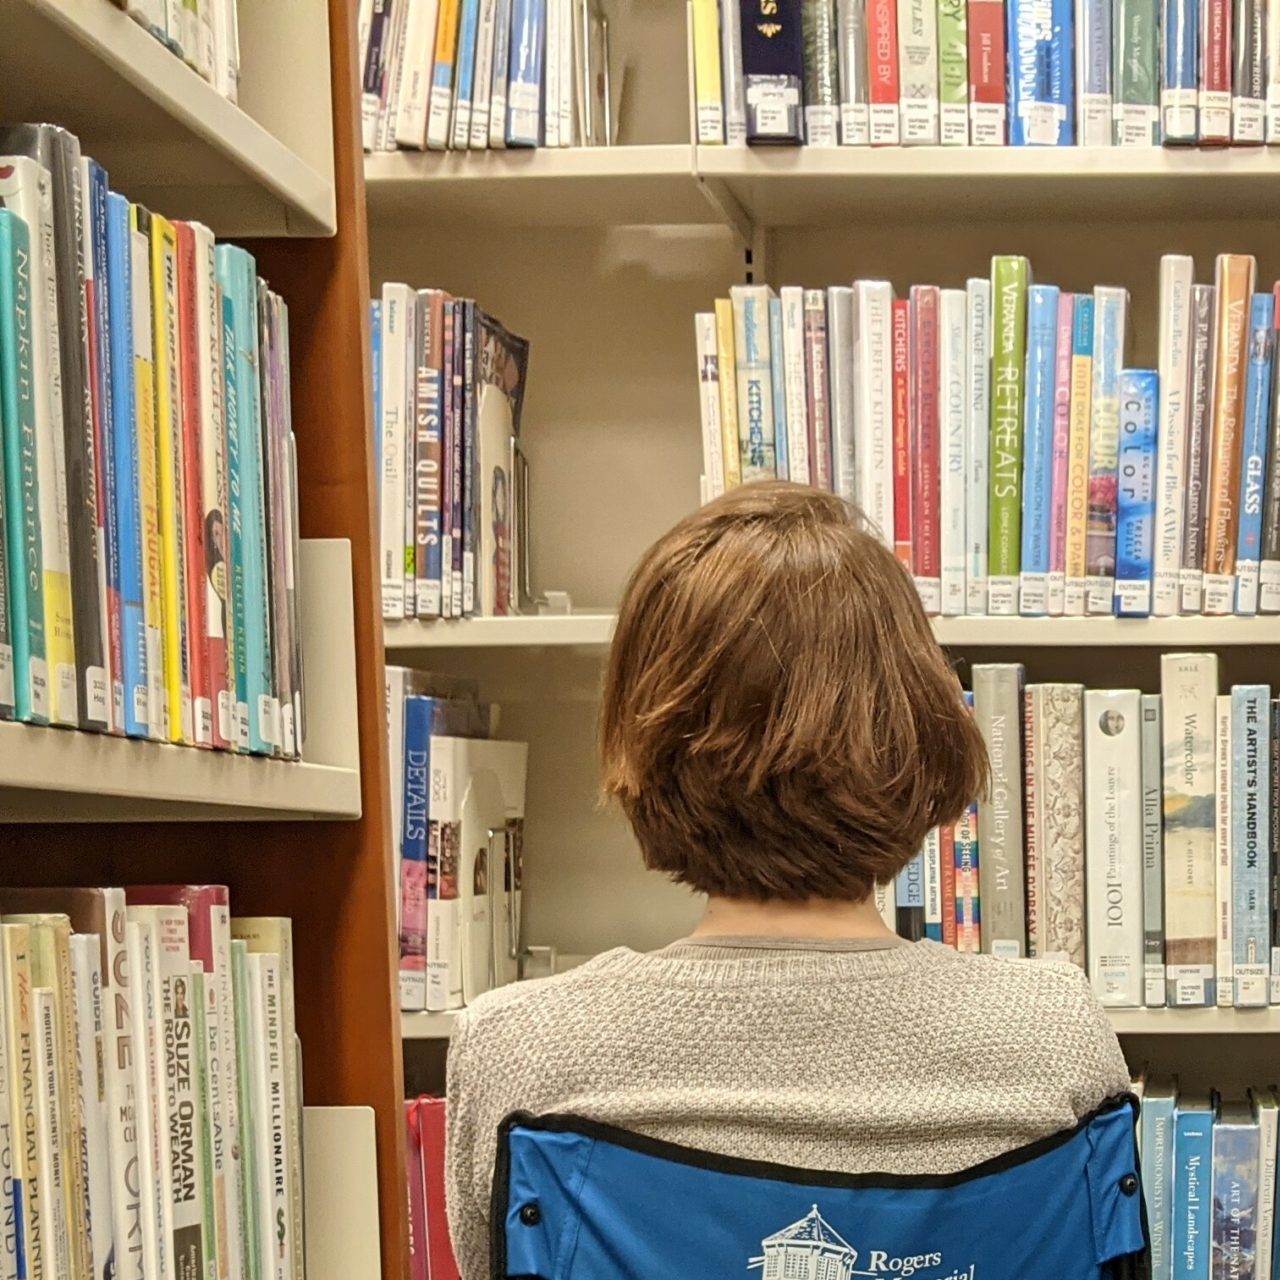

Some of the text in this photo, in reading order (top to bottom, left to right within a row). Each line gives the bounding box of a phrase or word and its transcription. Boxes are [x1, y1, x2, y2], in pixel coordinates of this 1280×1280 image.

[895, 309, 907, 372] KITCHENS
[973, 294, 985, 411] COTTAGE LIVING
[994, 281, 1019, 498] VERANDA RETREATS
[15, 249, 40, 593] Napkin Finance
[224, 323, 242, 539] TALK MONEY TO ME
[417, 366, 439, 546] AMISH QUILTS
[747, 380, 765, 466] KITCHENS
[1245, 456, 1262, 513] GLASS
[407, 750, 426, 840] DETAILS
[992, 715, 1008, 891] National Gallery of Art
[1144, 785, 1158, 869] Alla Prima
[1247, 698, 1257, 868] THE ARTIST'S HANDBOOK
[1107, 883, 1123, 927] 1001
[20, 1032, 38, 1171] FINANCIAL
[162, 976, 182, 1204] THE ROAD TO WEALTH
[175, 1020, 194, 1202] SUZE ORMAN
[208, 1025, 225, 1171] Be CentsAble
[266, 968, 284, 1198] THE MINDFUL MILLIONAIRE
[1153, 1117, 1165, 1268] IMPRESSIONISTS WINTER
[1184, 1156, 1200, 1270] Mystical Landscapes
[1231, 1181, 1240, 1203] ART
[1231, 1208, 1239, 1224] OF
[1231, 1228, 1239, 1253] THE
[868, 1250, 942, 1276] Rogers
